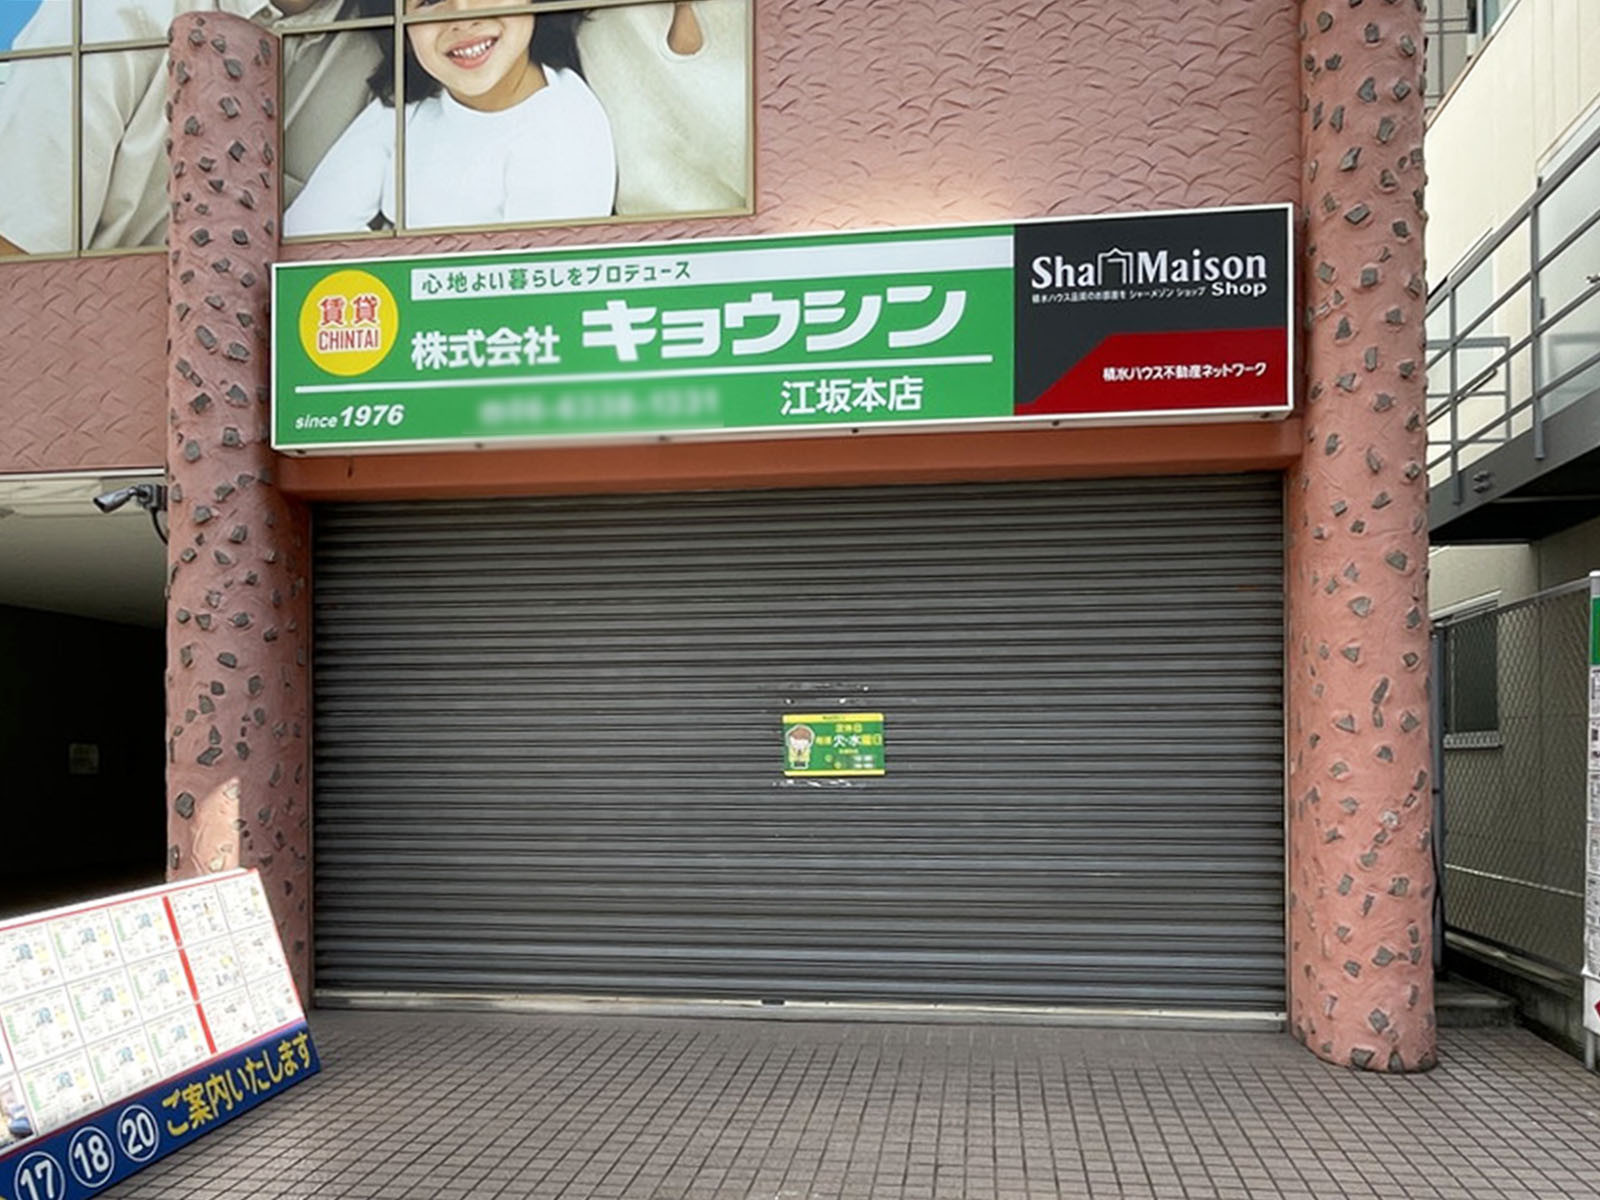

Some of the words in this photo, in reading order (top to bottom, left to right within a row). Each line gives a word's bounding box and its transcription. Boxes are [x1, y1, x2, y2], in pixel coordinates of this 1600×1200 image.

[422, 262, 691, 295] 心地よい暮らしをプロデュース
[1211, 282, 1267, 297] Shop
[319, 295, 379, 327] 賃貸
[319, 330, 379, 351] CHINTAI
[411, 325, 560, 370] 株式会社
[582, 285, 966, 361] キョウシン
[780, 376, 923, 415] 江坂本店
[295, 414, 338, 429] since
[340, 404, 405, 427] 1976
[19, 1159, 57, 1200] 17
[73, 1135, 109, 1179] 18
[121, 1112, 155, 1155] 20
[162, 1032, 311, 1136] ご案内いたします
